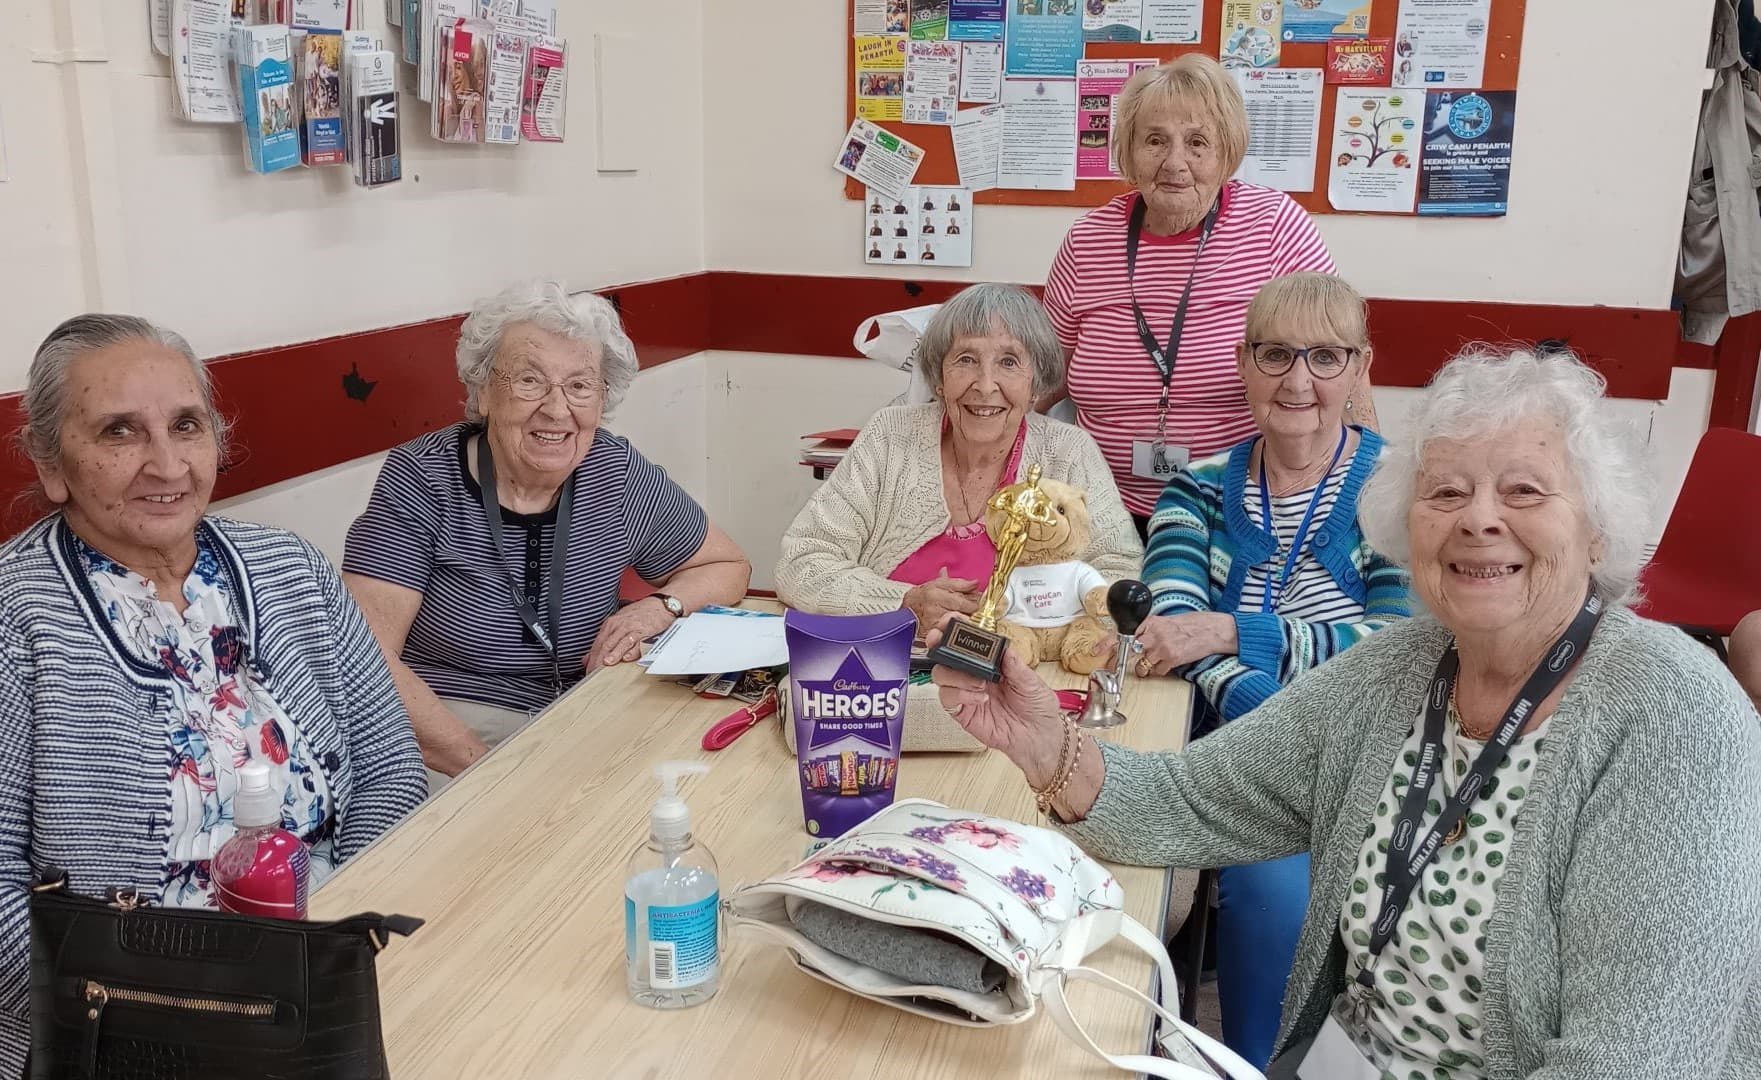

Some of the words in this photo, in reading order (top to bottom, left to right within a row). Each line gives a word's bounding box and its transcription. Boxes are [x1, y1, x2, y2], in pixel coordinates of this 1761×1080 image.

[858, 41, 881, 52] LAUGH
[884, 39, 892, 47] IN
[454, 51, 469, 59] AVON
[860, 48, 894, 62] PENARTH
[1425, 143, 1447, 151] CRIW
[1473, 142, 1511, 150] PENARTH
[1154, 464, 1178, 474] 694
[1024, 591, 1063, 605] #YouCan
[1034, 600, 1052, 609] Care
[957, 632, 990, 653] Winner
[1551, 642, 1573, 669] Specsavers
[833, 679, 871, 693] Cadbury
[802, 687, 900, 719] HEROES
[820, 722, 841, 730] SHARE
[842, 722, 863, 730] GOOD
[864, 721, 884, 729] TIMES
